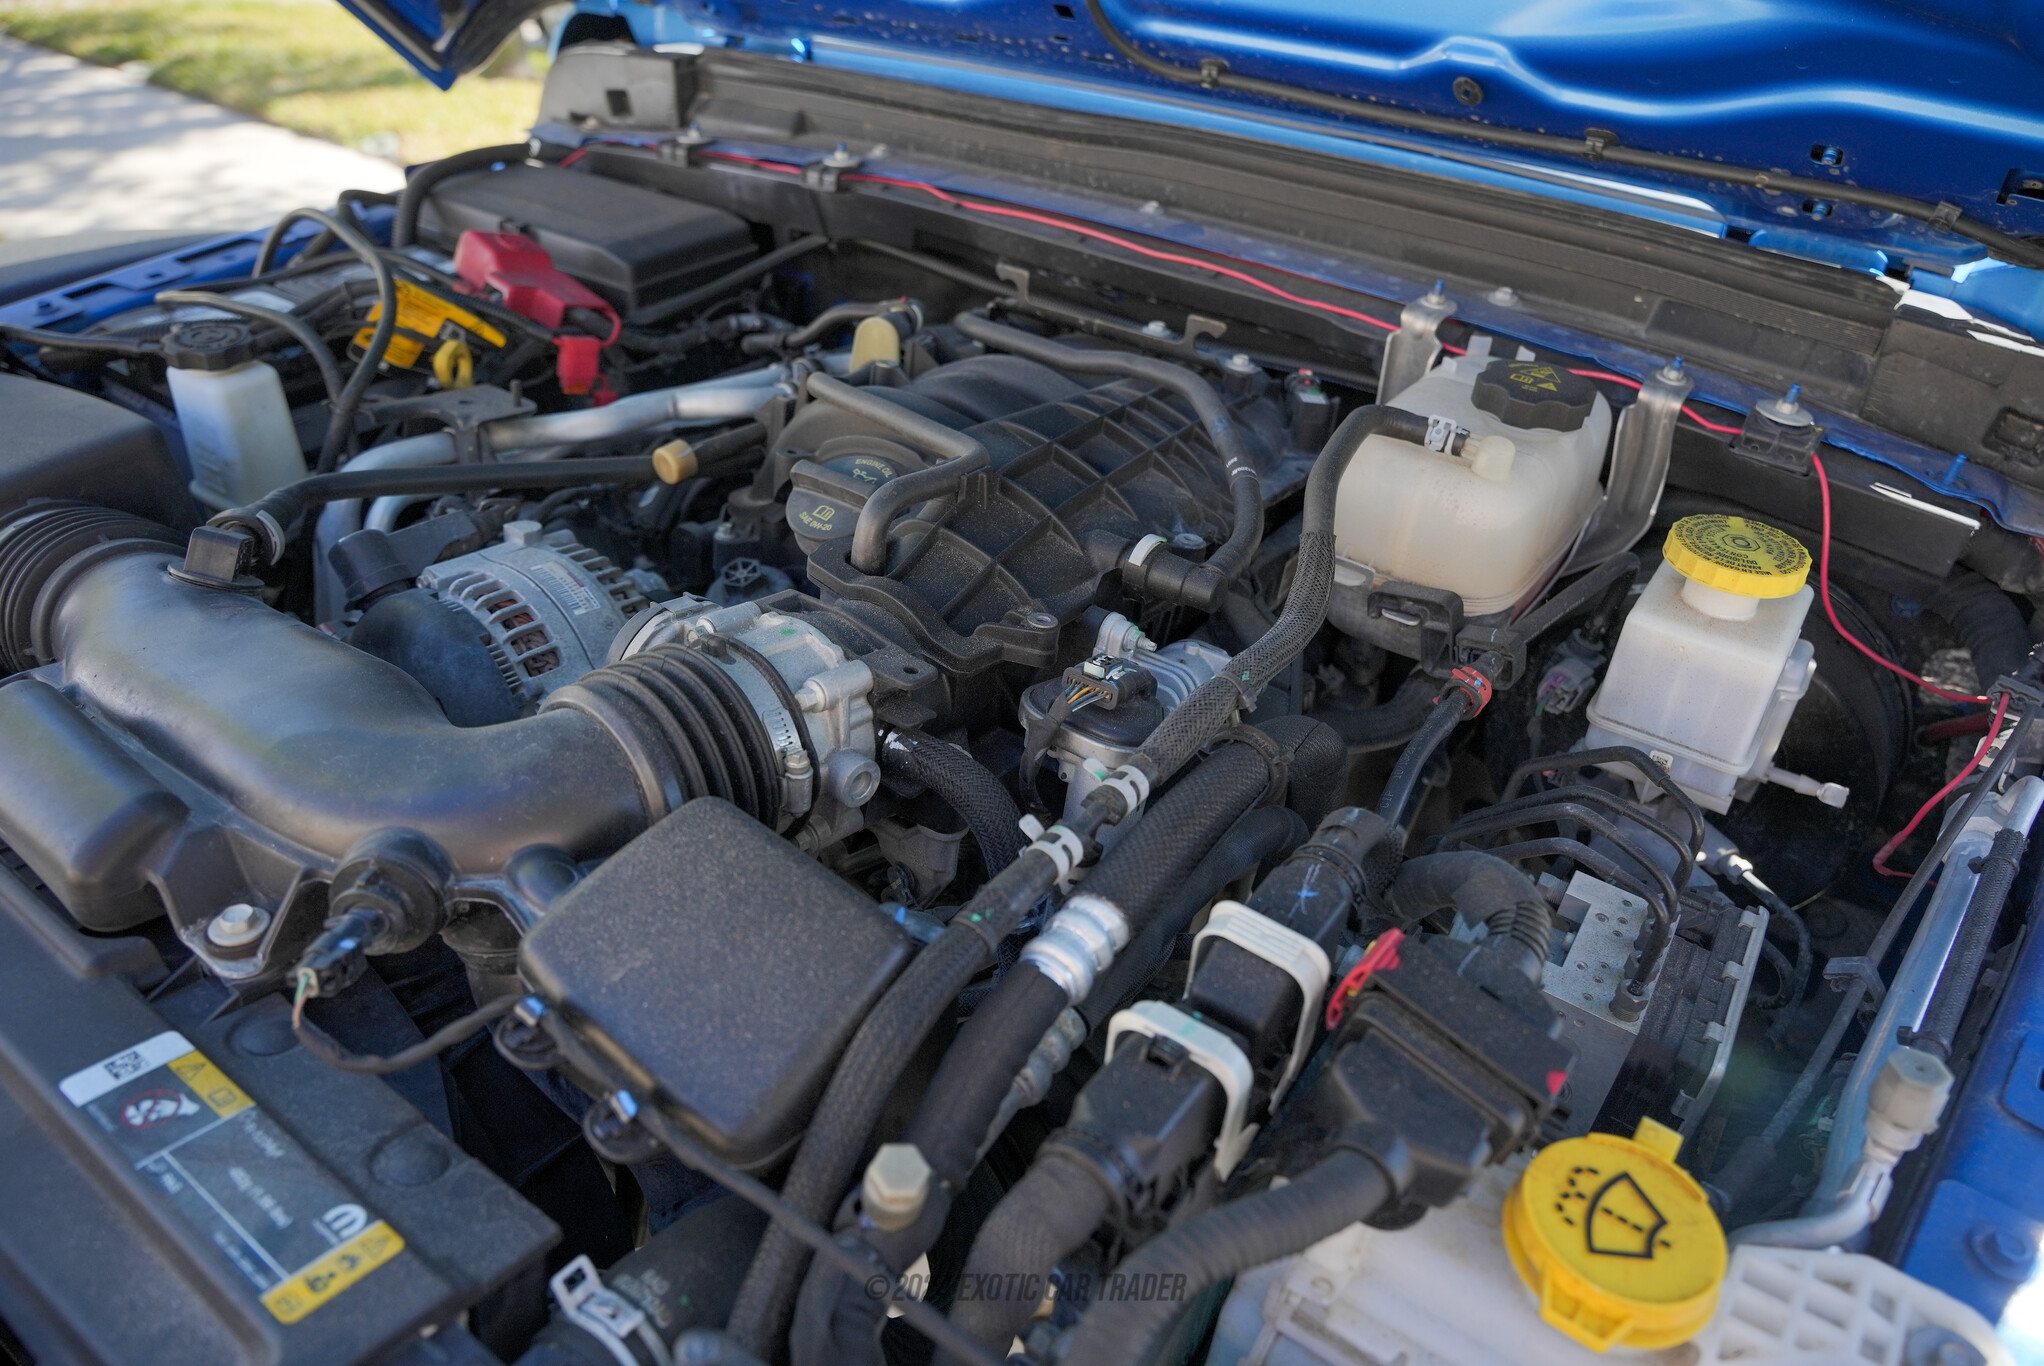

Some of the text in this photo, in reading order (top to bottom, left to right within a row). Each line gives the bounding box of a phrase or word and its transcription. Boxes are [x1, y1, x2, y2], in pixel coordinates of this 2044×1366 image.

[855, 459, 893, 478] ENGINE OIL
[799, 512, 812, 524] SAE
